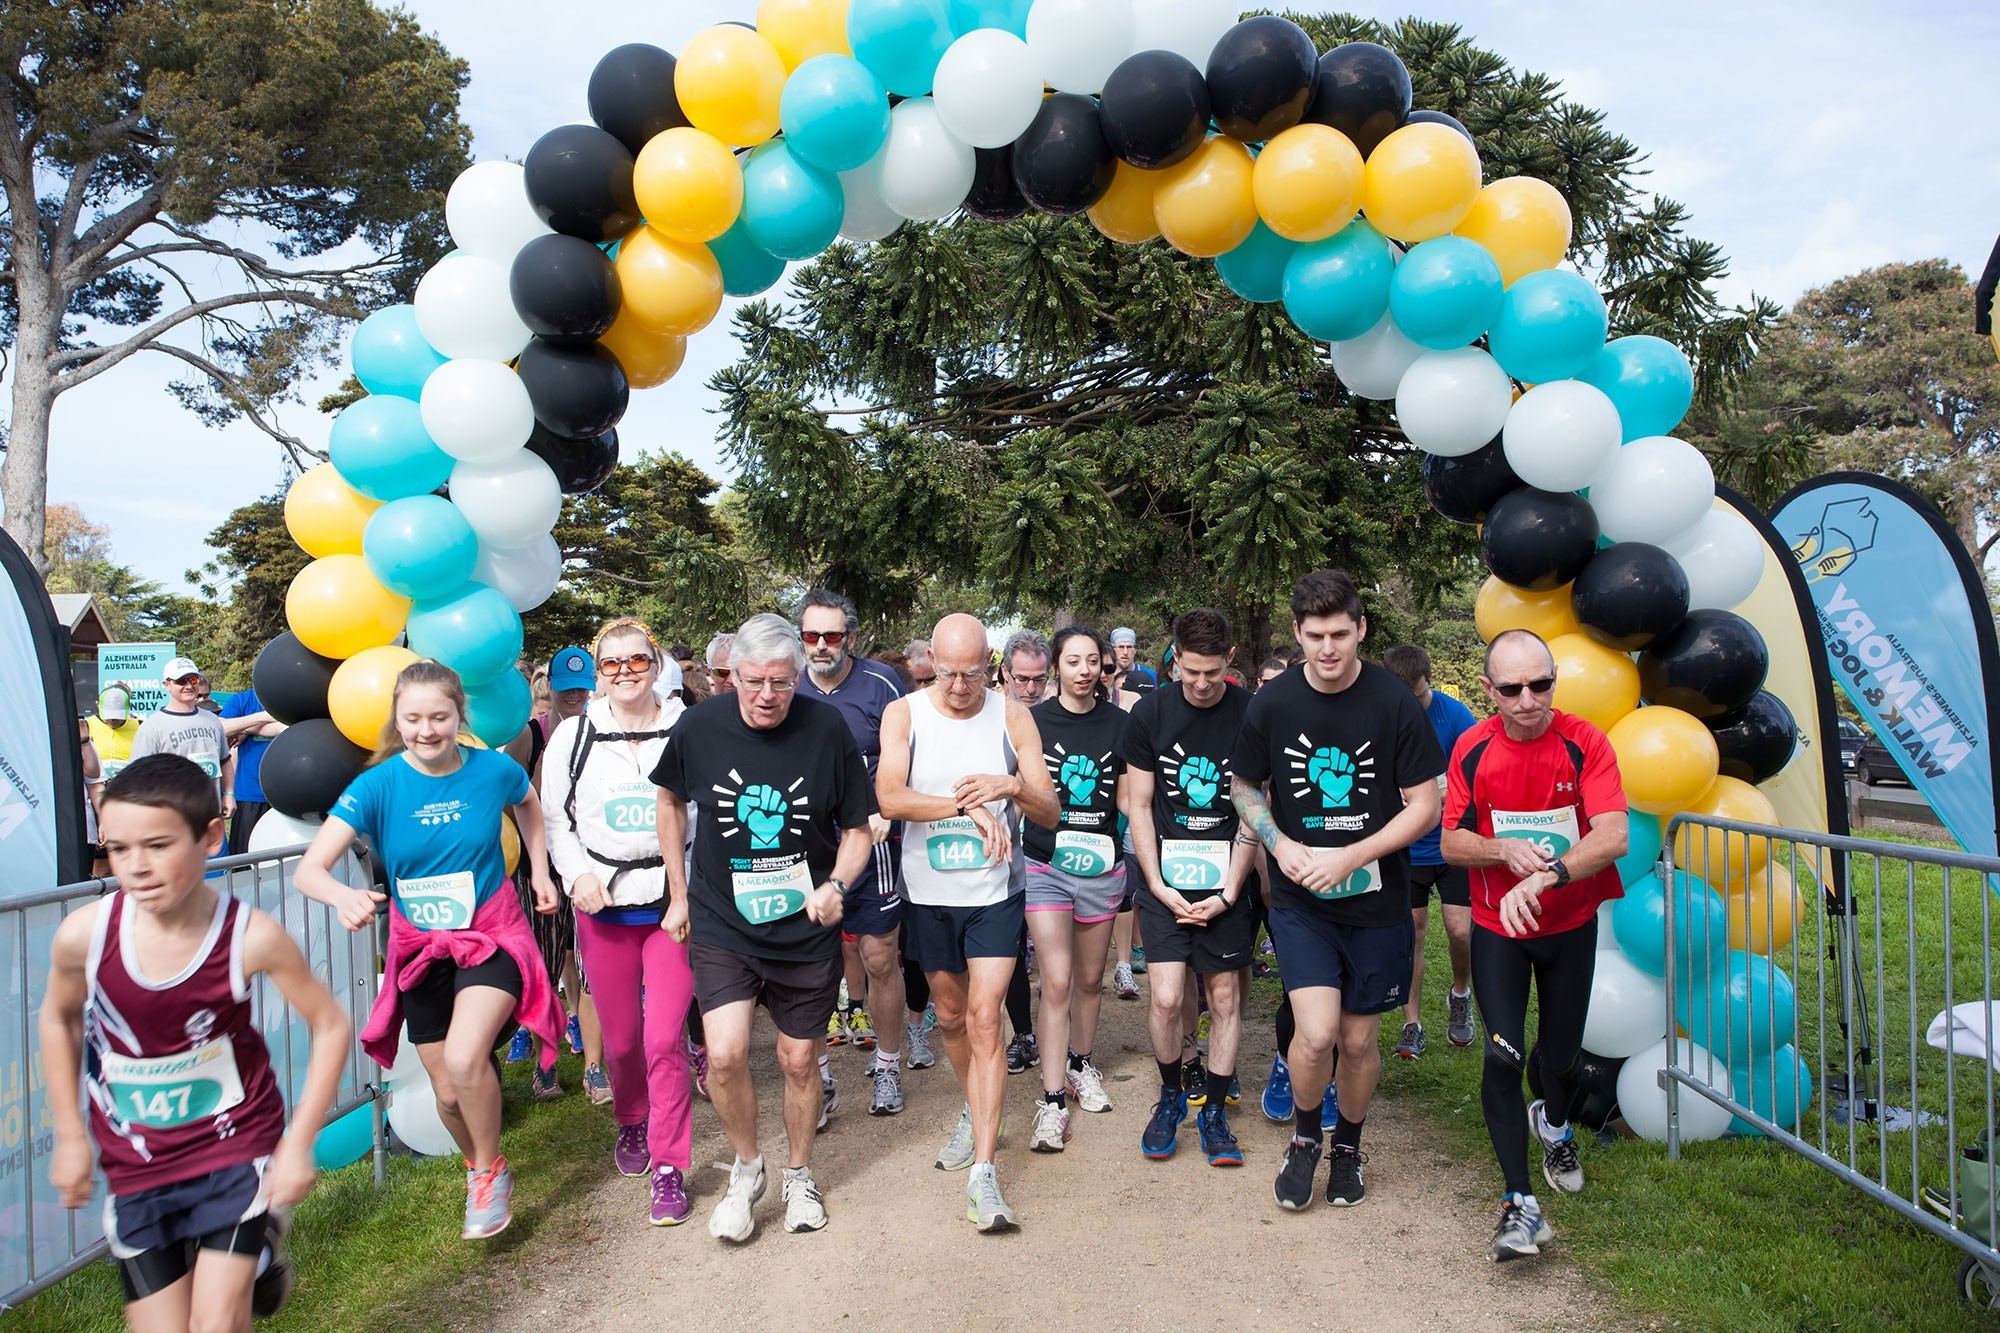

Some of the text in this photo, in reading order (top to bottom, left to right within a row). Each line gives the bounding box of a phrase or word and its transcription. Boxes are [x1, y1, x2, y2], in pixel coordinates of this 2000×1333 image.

[104, 654, 156, 662] ALZHEIMER'S
[130, 691, 167, 700] ENTIA-
[169, 727, 217, 749] SAUCONY
[617, 784, 657, 792] MEMOR
[615, 803, 657, 827] 206
[1324, 812, 1370, 822] ALZHEIMER'S
[1506, 815, 1554, 825] MEMORY
[937, 820, 974, 829] MEMOR
[1066, 835, 1101, 845] MEMORY
[937, 840, 976, 864] 144
[752, 853, 801, 864] ALZHEIMER'S
[752, 860, 794, 869] AUSTRALIA
[1060, 851, 1094, 872] 219
[746, 873, 792, 886] MEMORY
[1173, 863, 1206, 885] 221
[405, 880, 452, 892] MEMORY
[408, 900, 454, 925] 205
[749, 894, 789, 919] 173
[129, 1084, 193, 1122] 147
